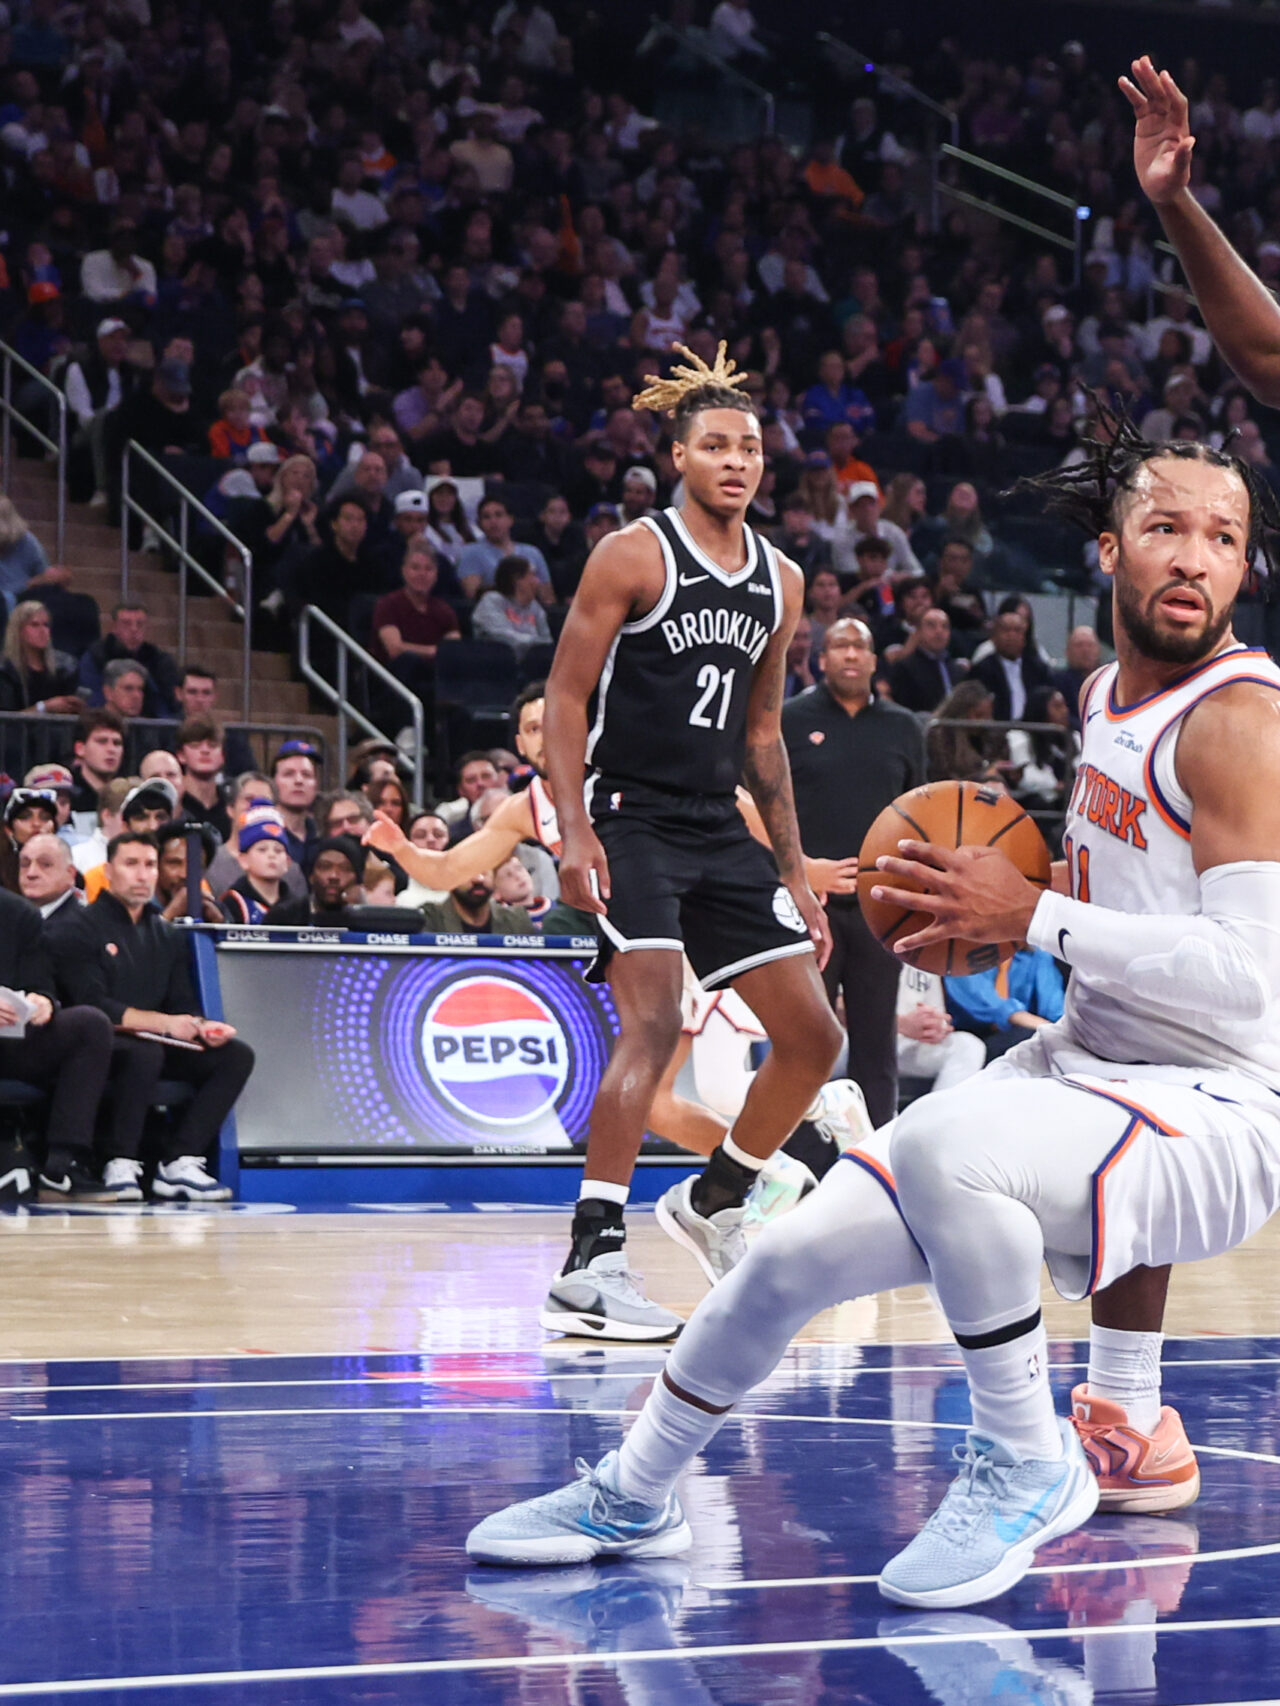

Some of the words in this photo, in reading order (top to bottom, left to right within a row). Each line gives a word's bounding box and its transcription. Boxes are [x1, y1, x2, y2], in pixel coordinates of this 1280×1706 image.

[661, 608, 769, 665] BROOKLYN
[688, 664, 736, 730] 21
[366, 933, 409, 944] CHASE
[435, 934, 478, 946] CHASE
[503, 935, 545, 947] CHASE
[570, 937, 597, 948] CHA
[433, 1036, 558, 1065] PEPSI
[472, 1145, 548, 1155] DAKTRONICS
